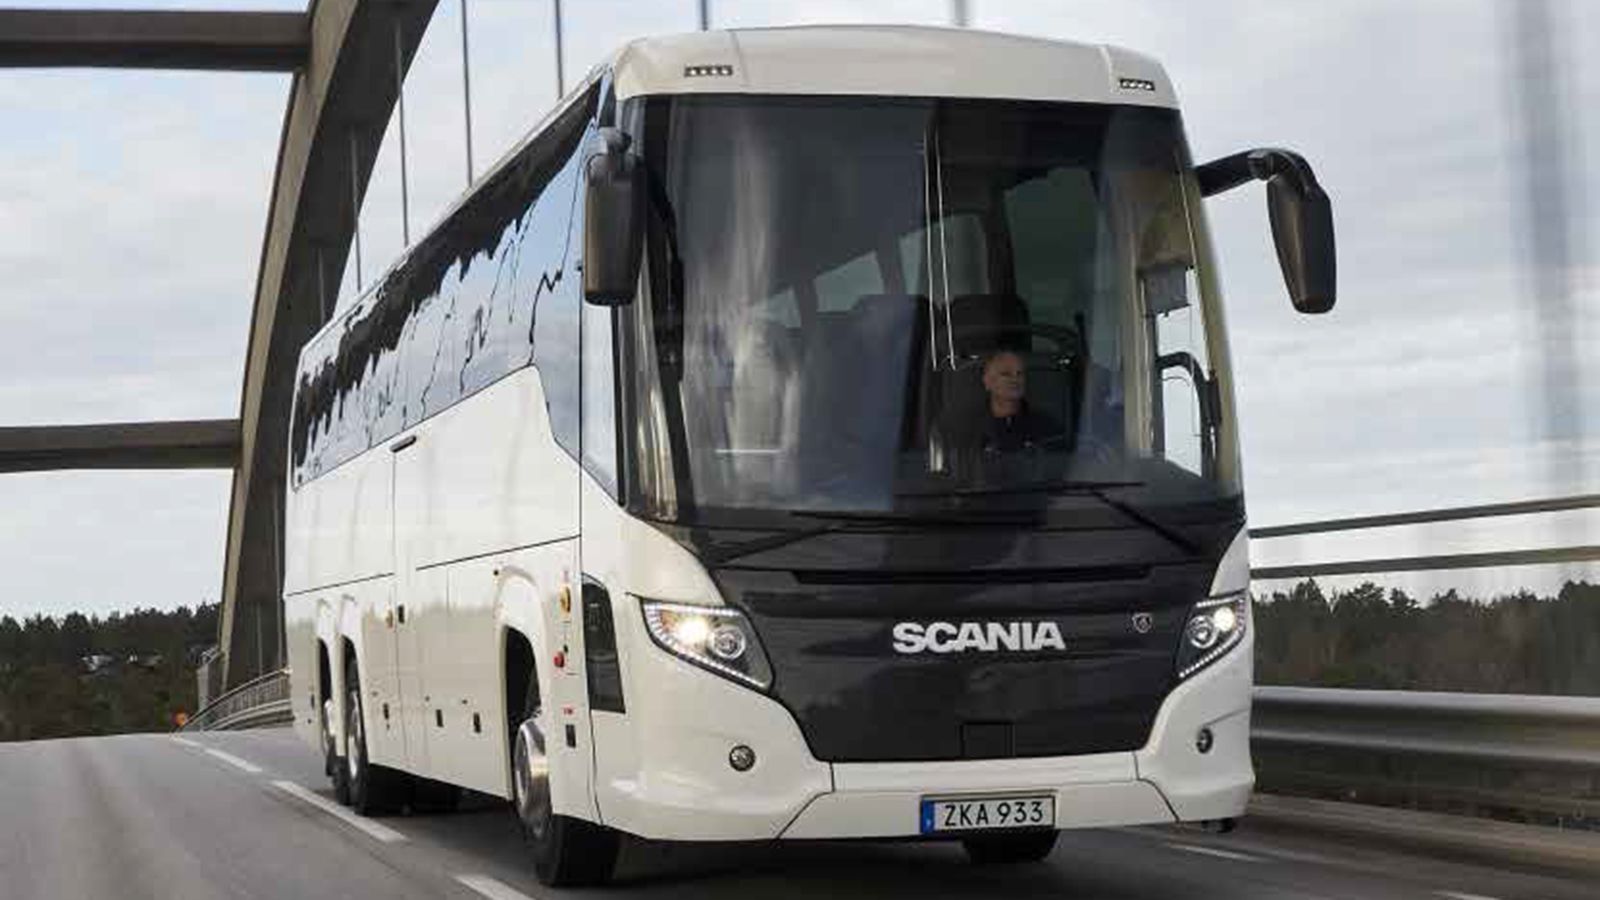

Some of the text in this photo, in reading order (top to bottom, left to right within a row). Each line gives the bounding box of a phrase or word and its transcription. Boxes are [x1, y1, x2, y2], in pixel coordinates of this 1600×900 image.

[892, 621, 1066, 653] SCANIA
[944, 801, 1043, 826] ZKA 933
